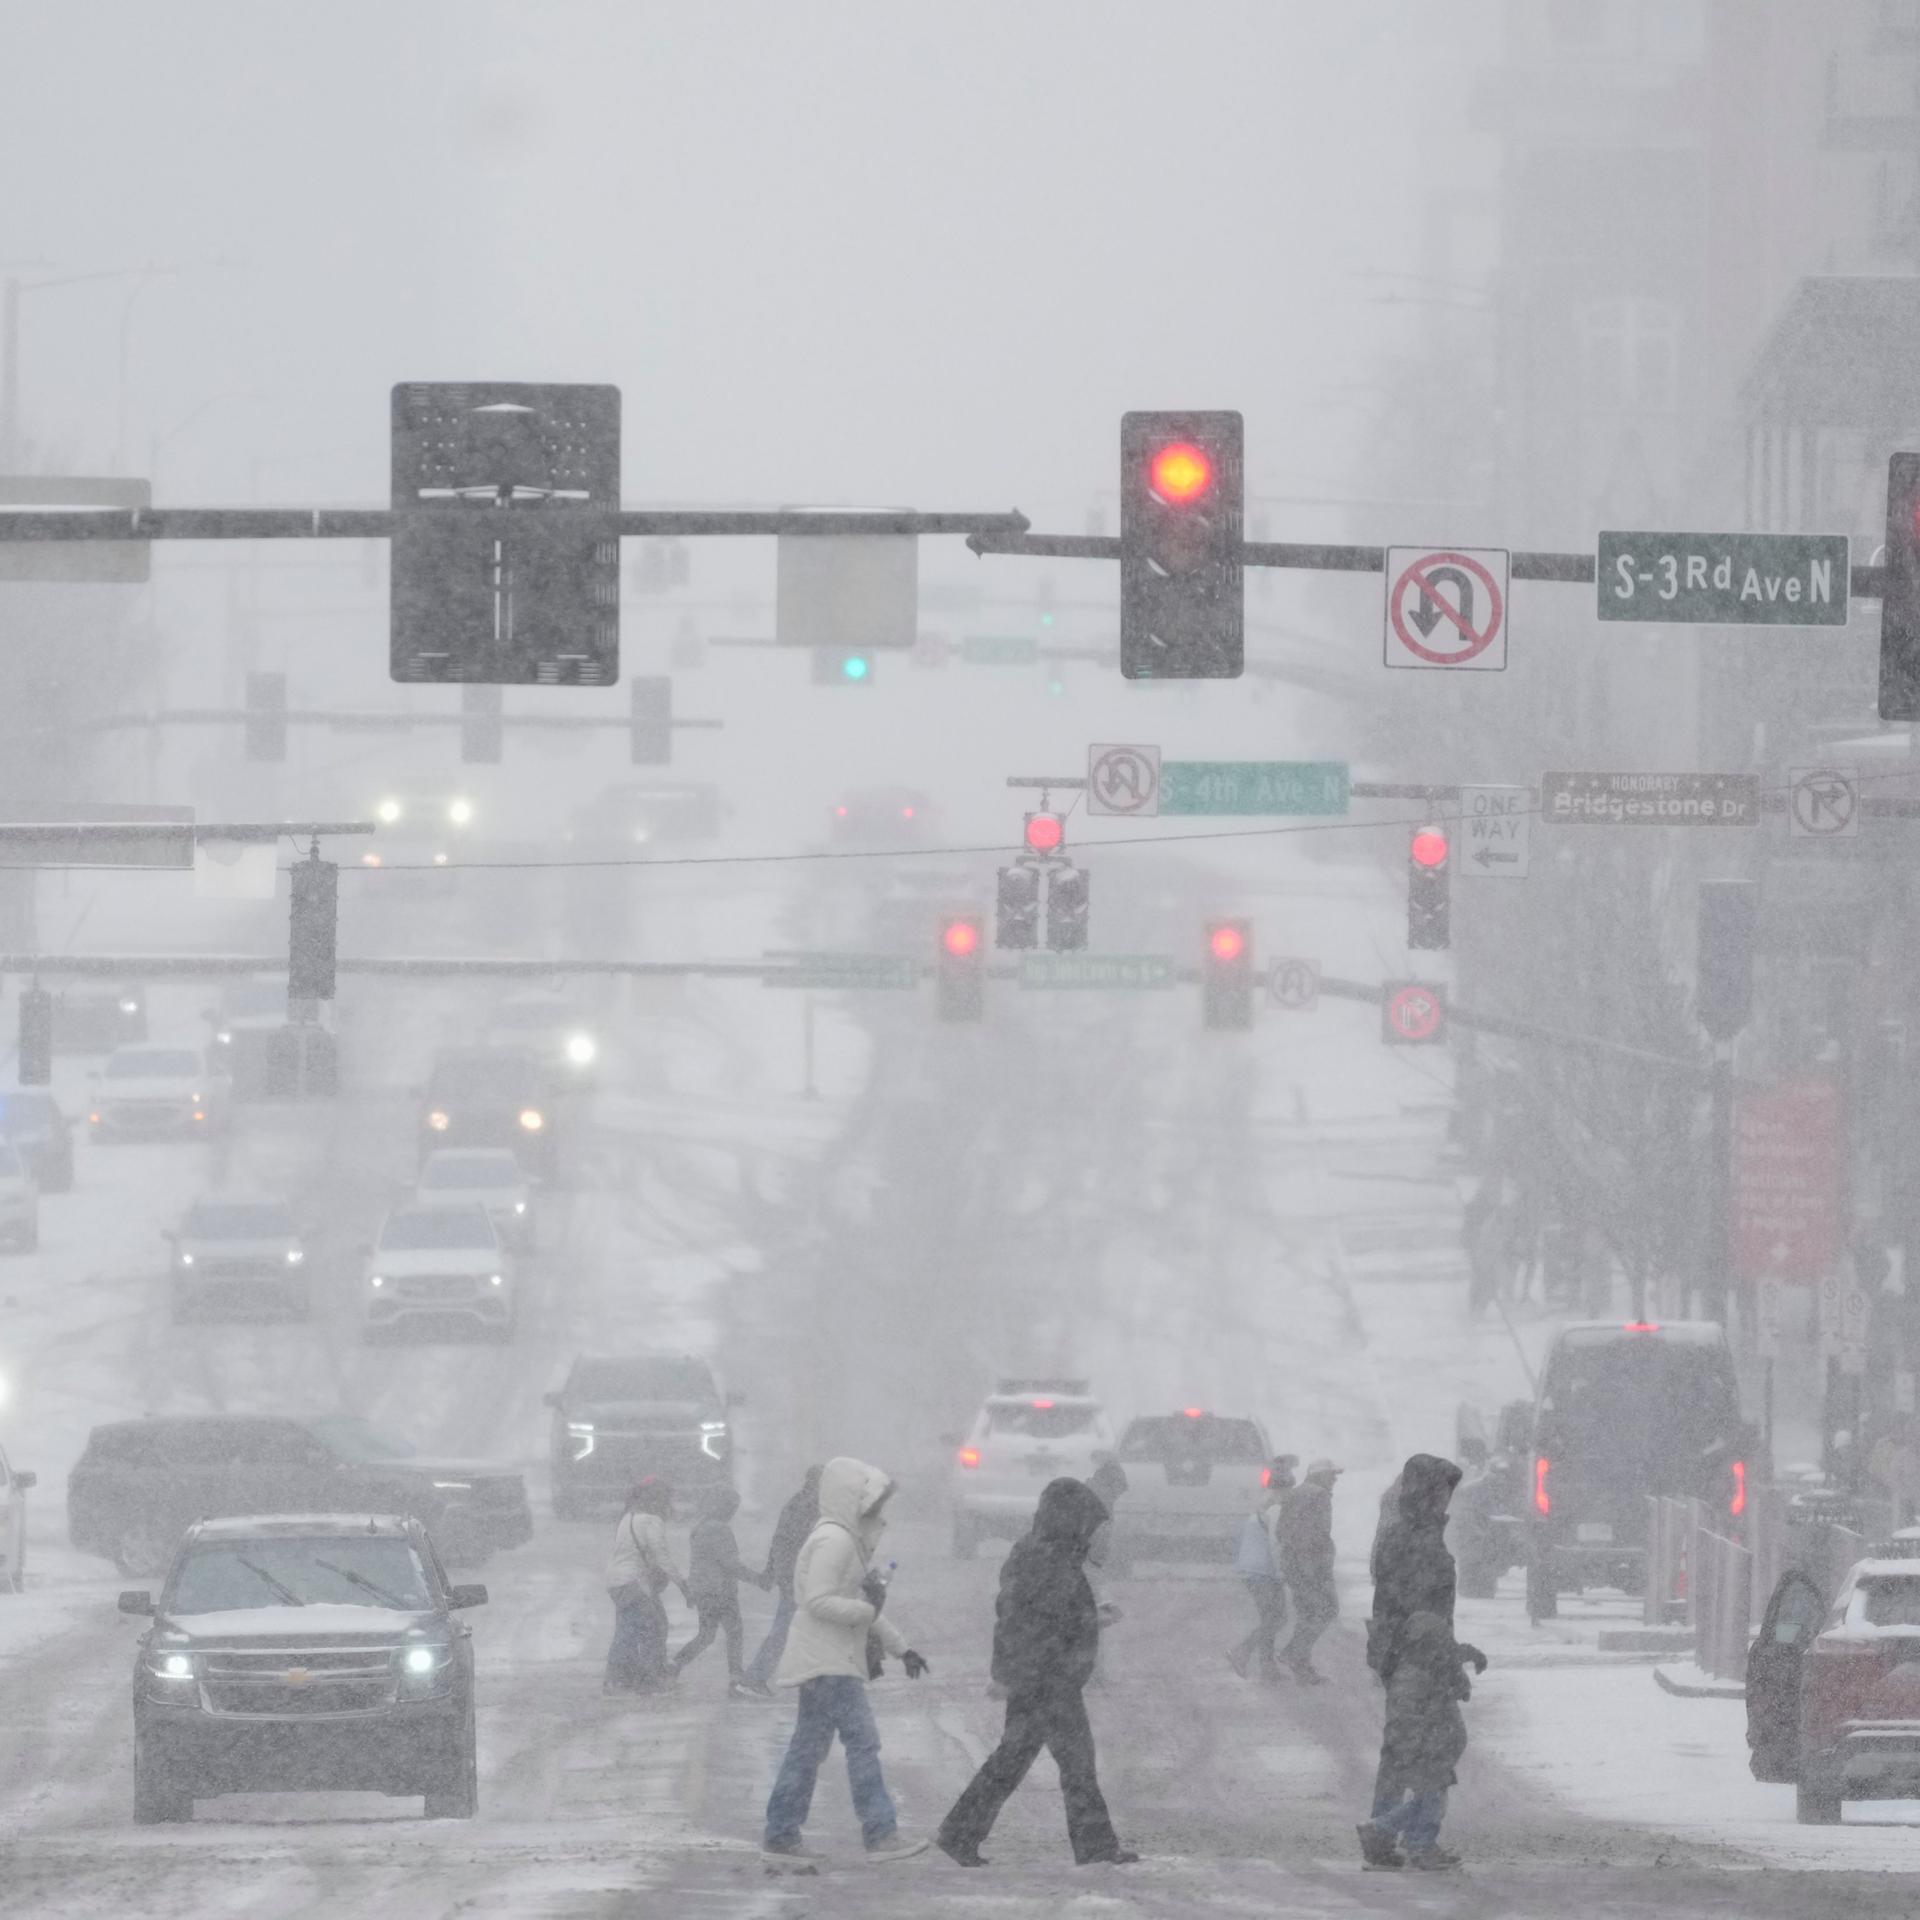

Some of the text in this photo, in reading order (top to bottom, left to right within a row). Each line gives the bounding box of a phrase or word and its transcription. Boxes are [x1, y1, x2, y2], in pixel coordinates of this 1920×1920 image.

[1740, 567, 1801, 602] Ave
[1810, 558, 1831, 603] N
[1612, 776, 1680, 791] HONORARY
[1473, 793, 1518, 816] ONE
[1554, 793, 1747, 821] Bridgestone Dr
[1471, 818, 1521, 840] WAY
